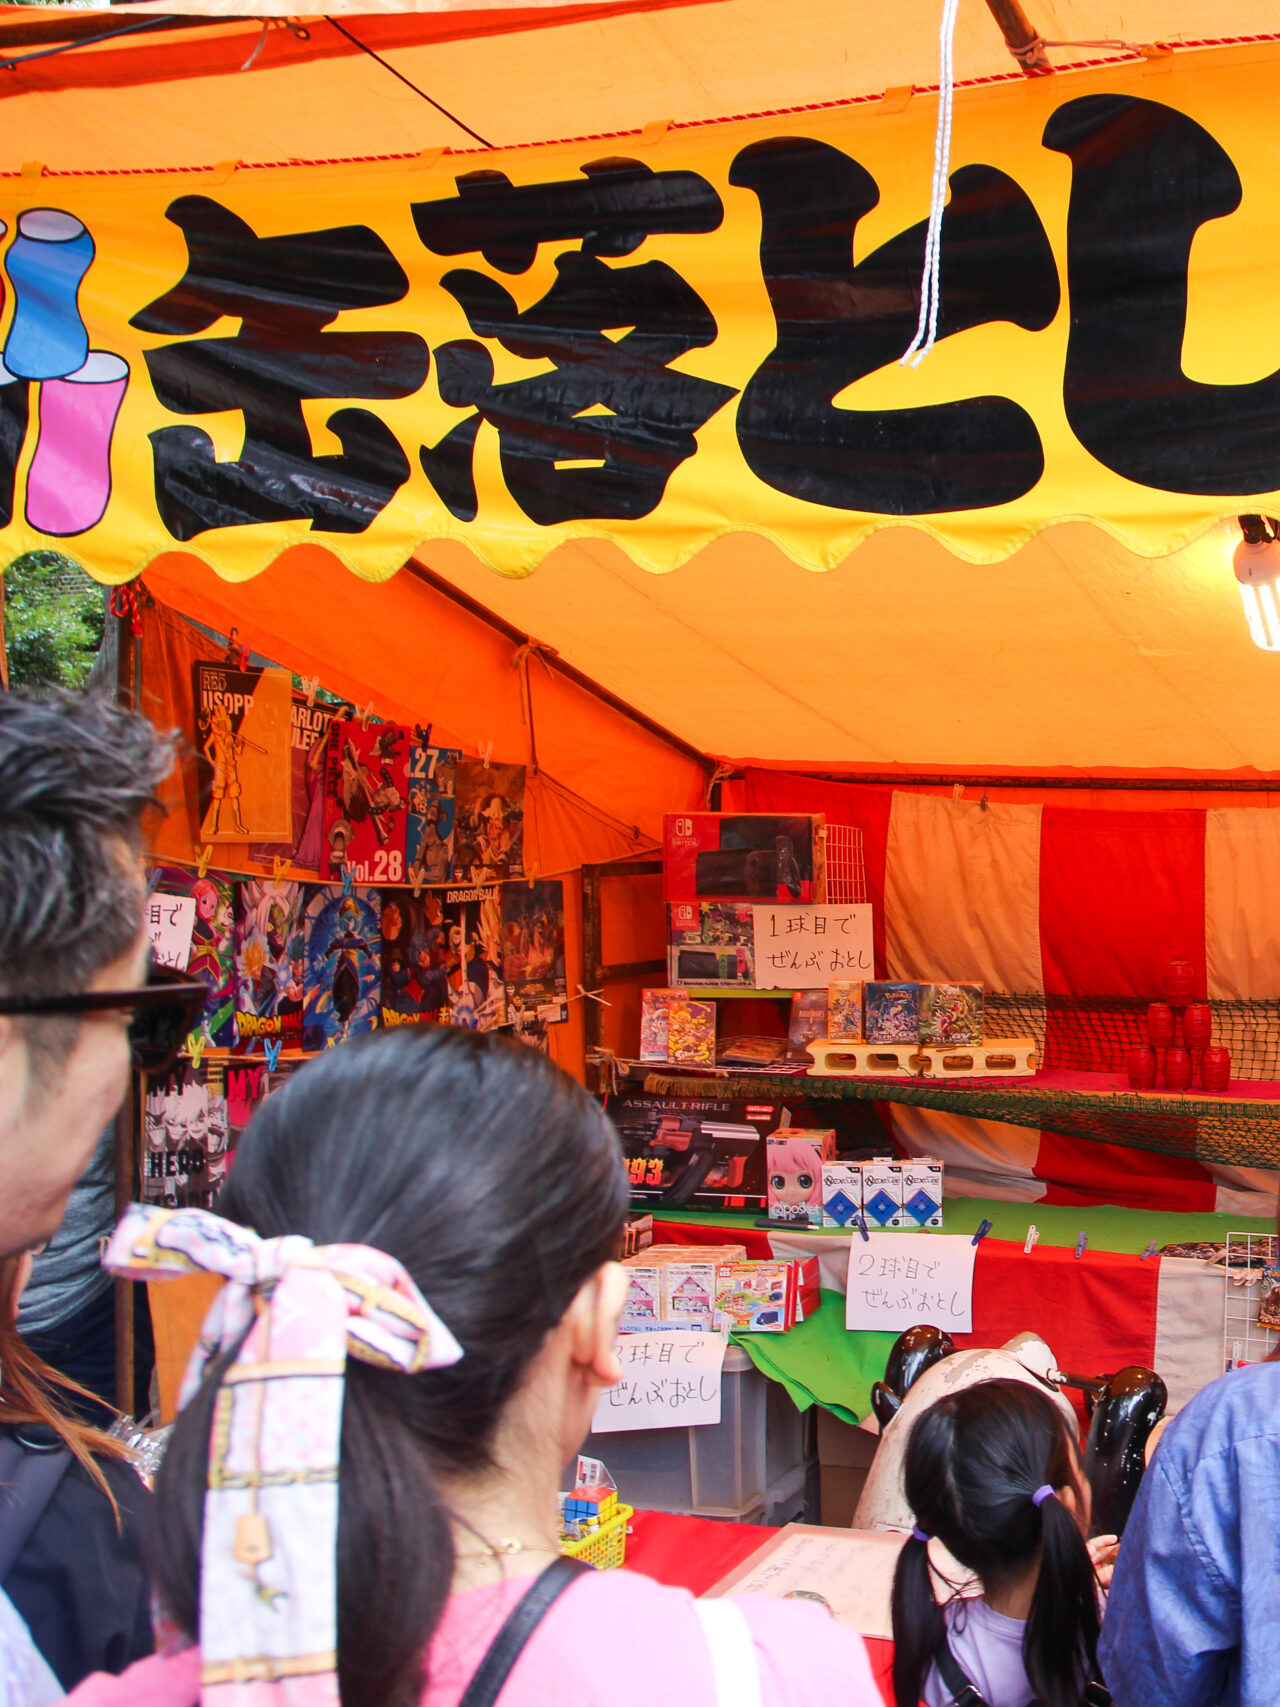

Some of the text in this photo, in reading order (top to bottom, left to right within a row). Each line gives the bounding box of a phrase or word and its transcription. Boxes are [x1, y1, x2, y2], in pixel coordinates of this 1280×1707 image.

[203, 674, 227, 691] RED
[769, 911, 856, 938] 1球目で
[766, 948, 872, 972] ぜんぶおとし
[236, 1010, 281, 1037] DRAGON
[227, 1066, 263, 1100] MY
[859, 1254, 940, 1279] 2球目で
[861, 1287, 966, 1317] ぜんぶおとし
[600, 1375, 717, 1408] ぜんぶおとし
